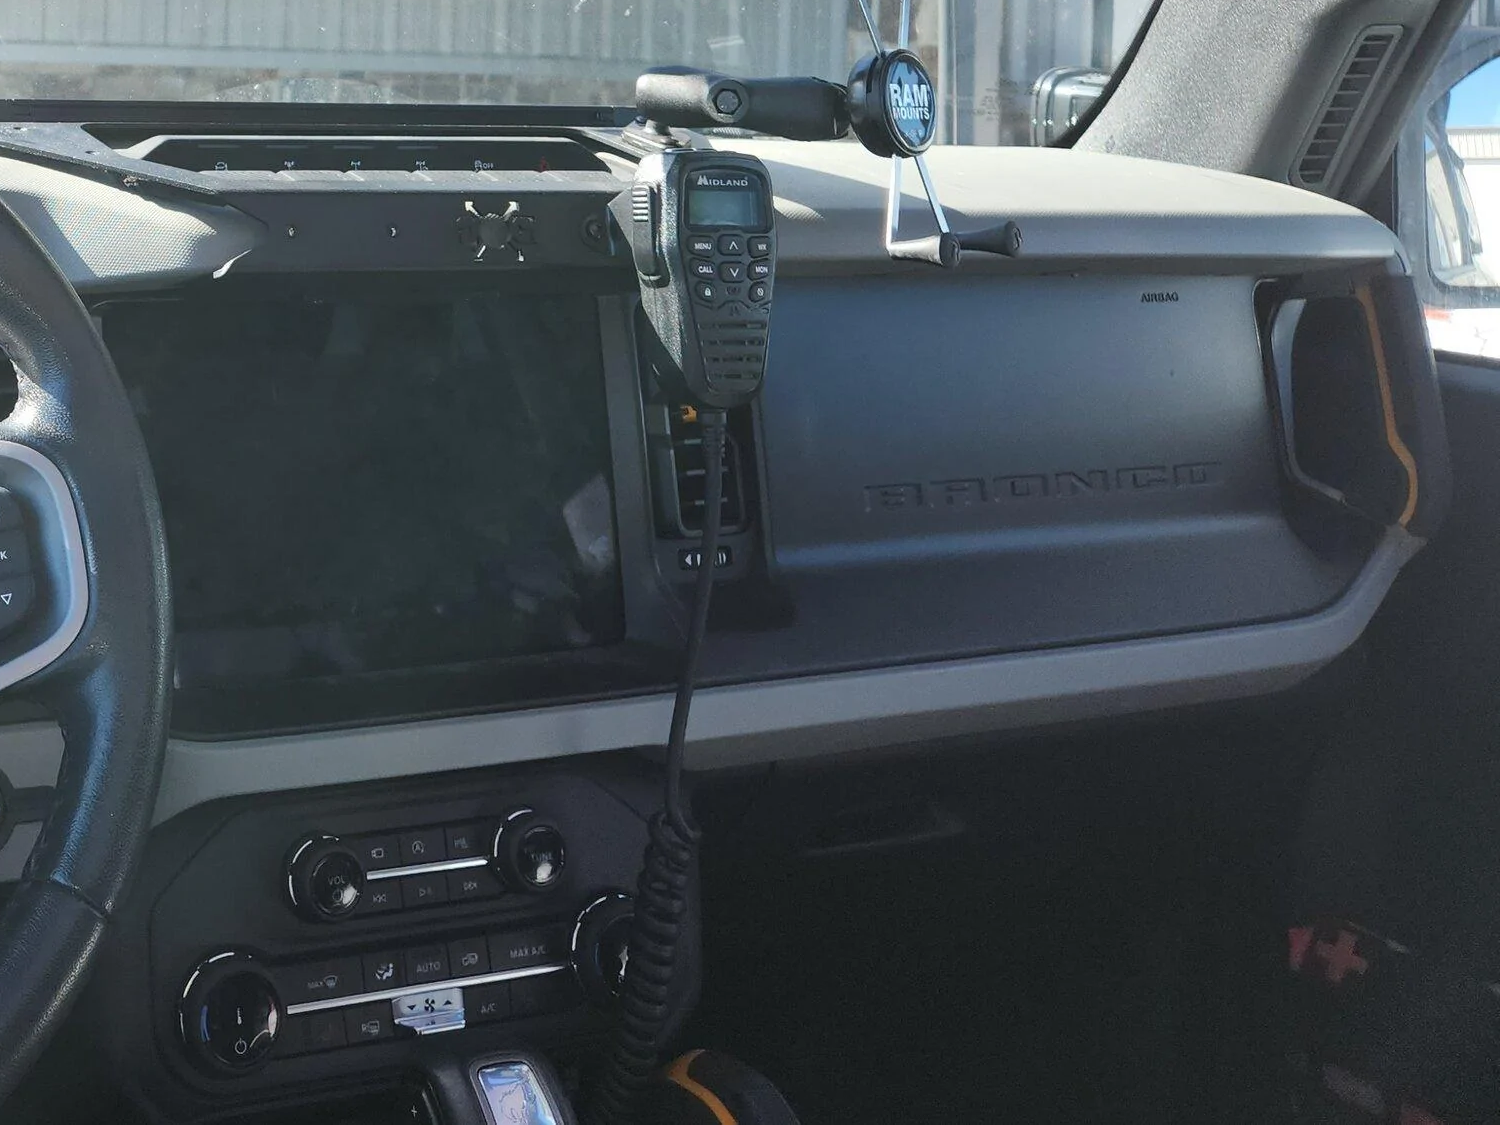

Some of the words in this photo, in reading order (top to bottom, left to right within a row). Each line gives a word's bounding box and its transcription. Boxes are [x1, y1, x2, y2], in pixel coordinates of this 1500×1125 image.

[889, 83, 929, 107] RAM
[892, 106, 930, 120] MOUNTS
[694, 242, 712, 251] MENU
[698, 265, 713, 273] CALL
[755, 265, 768, 273] MON
[863, 461, 1222, 512] BRONCO
[328, 875, 346, 885] VOL
[510, 948, 529, 959] MAX
[531, 945, 547, 956] A/C
[416, 961, 441, 973] AUTO
[481, 1003, 497, 1014] A/C
